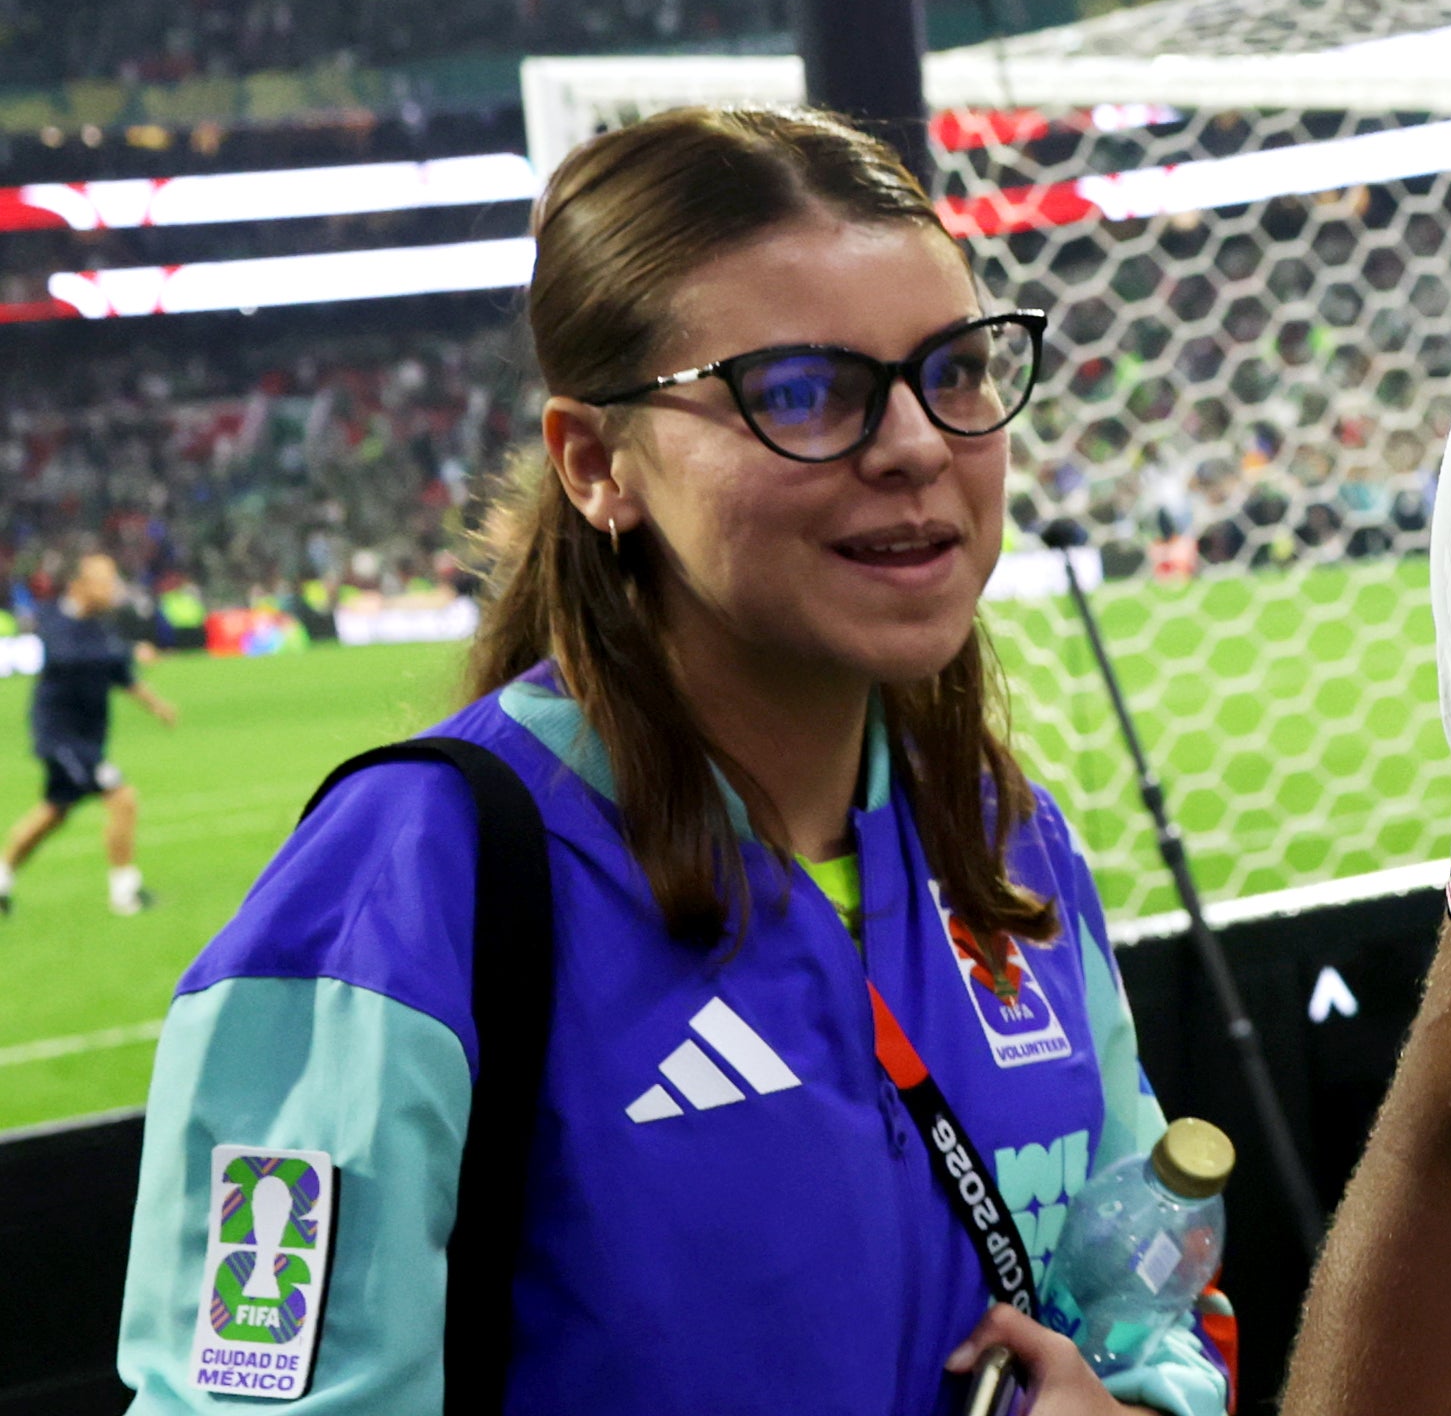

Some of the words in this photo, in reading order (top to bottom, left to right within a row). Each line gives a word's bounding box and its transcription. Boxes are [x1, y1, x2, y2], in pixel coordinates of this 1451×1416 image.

[999, 1002, 1035, 1023] FIFA
[996, 1037, 1067, 1062] VOLUNTEER
[931, 1117, 1001, 1231] 2026
[986, 1232, 1024, 1292] CUP
[236, 1304, 281, 1328] FIFA
[201, 1348, 272, 1369] CIUDAD
[275, 1354, 300, 1371] DE
[196, 1366, 295, 1391] MÉXICO
